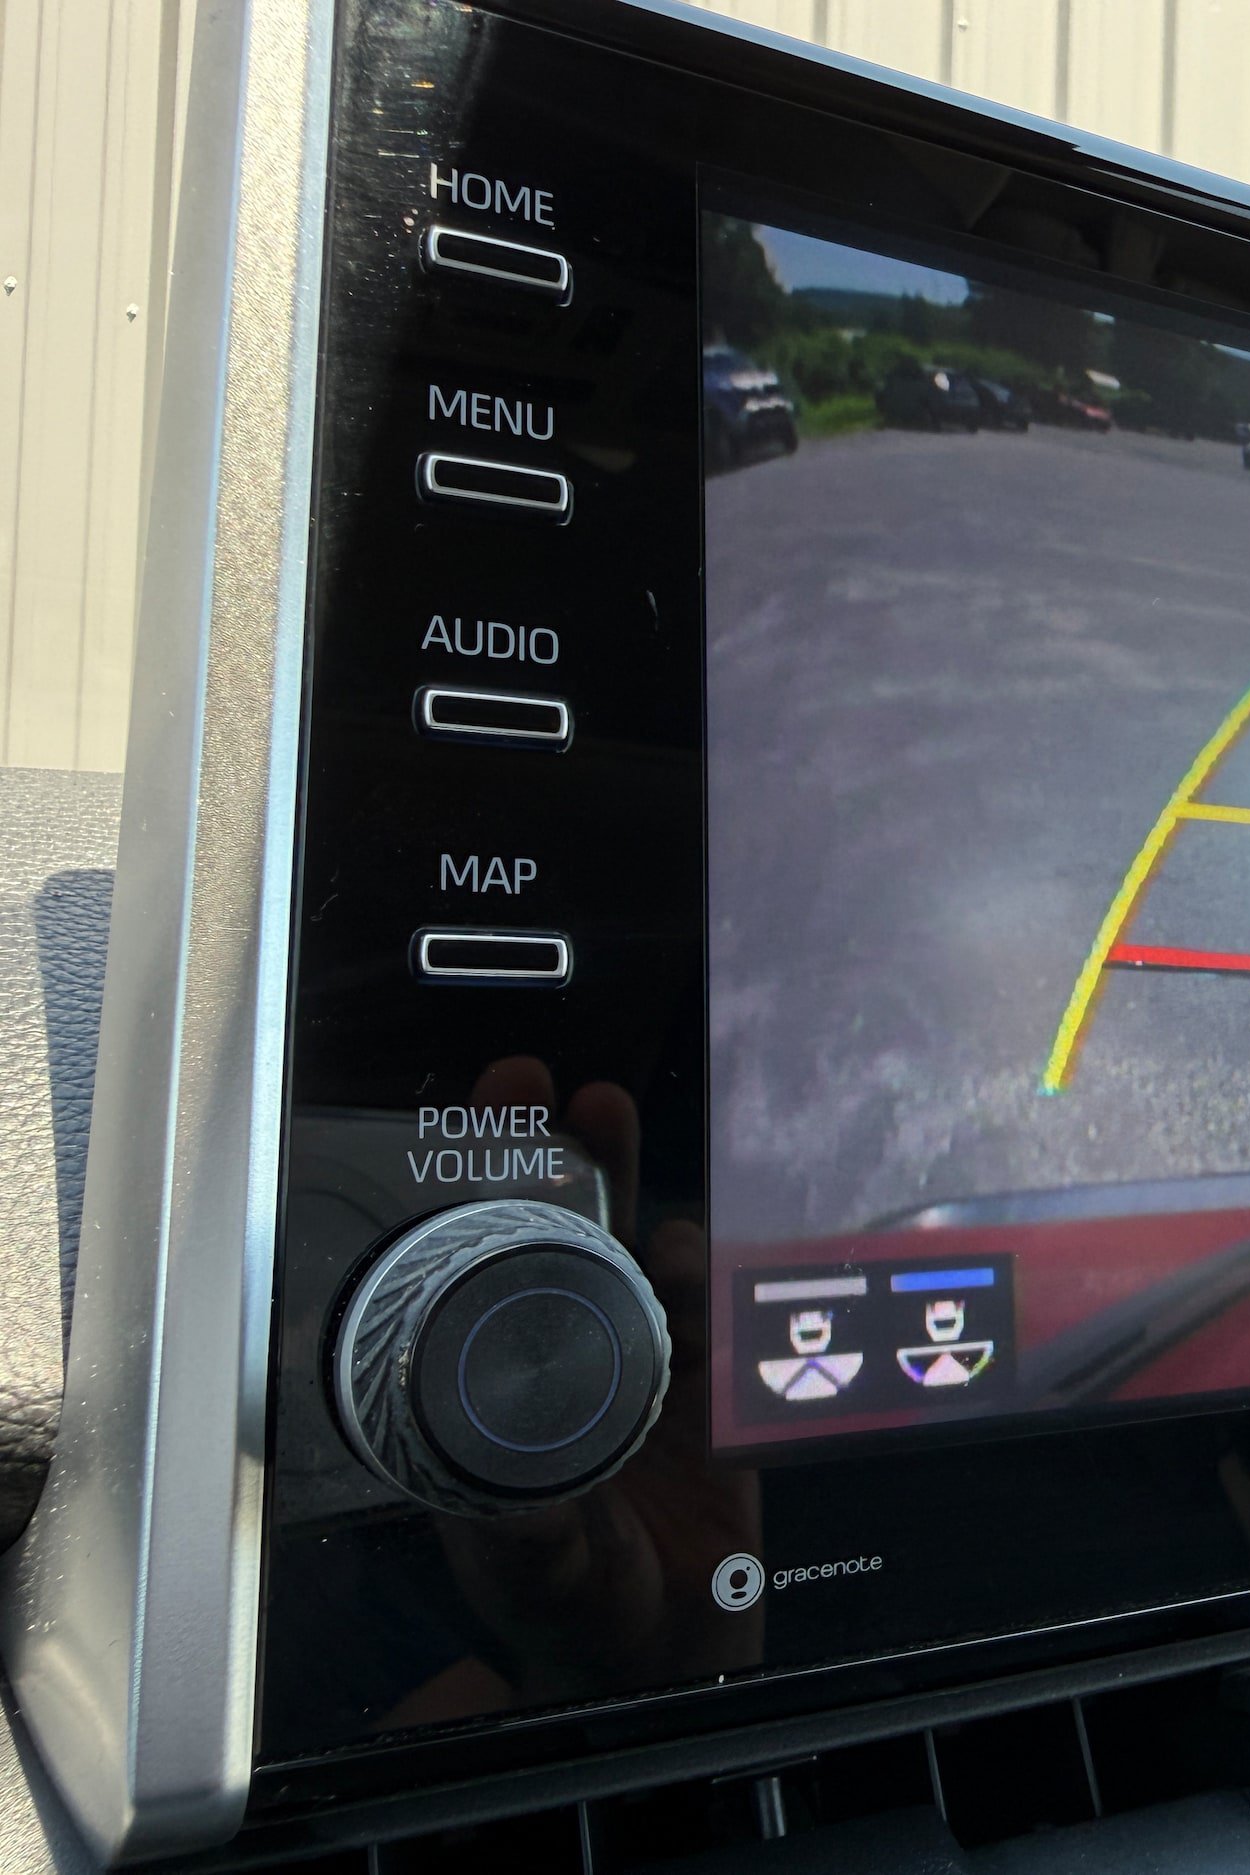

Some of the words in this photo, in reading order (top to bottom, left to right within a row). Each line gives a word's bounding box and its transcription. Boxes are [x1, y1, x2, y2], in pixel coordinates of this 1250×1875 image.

[430, 162, 555, 226] HOME
[428, 384, 554, 440] MENU
[421, 614, 559, 665] AUDIO
[440, 853, 538, 895] MAP
[418, 1105, 551, 1139] POWER
[407, 1147, 565, 1183] VOLUME
[772, 1555, 883, 1590] gracenote
